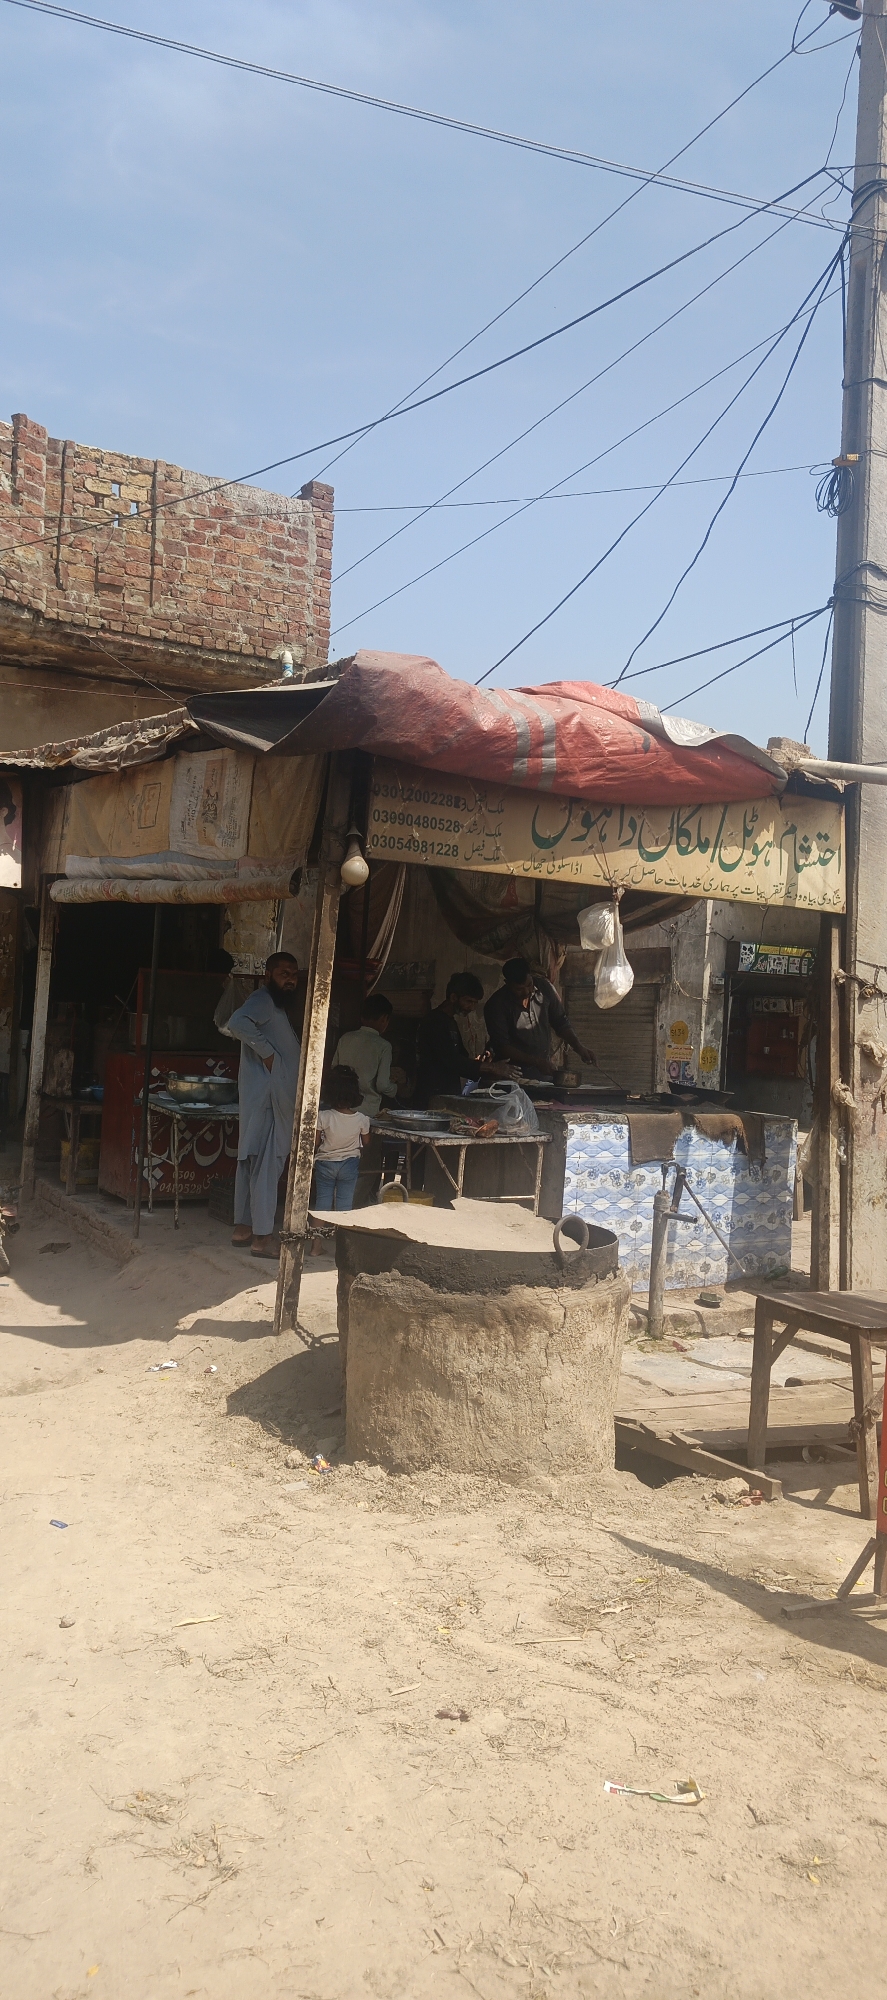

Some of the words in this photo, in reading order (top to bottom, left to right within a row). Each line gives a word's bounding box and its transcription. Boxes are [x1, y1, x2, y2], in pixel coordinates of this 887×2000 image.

[487, 799, 504, 814] ملک
[373, 809, 460, 833] 03090480528
[465, 821, 486, 836] ارشد
[531, 797, 613, 850] ہول
[485, 822, 503, 837] ملک
[371, 834, 459, 857] 03054981228
[464, 840, 485, 860] فیصل
[483, 846, 500, 861] ملک
[780, 823, 842, 876] احتشام
[631, 867, 663, 884] حاصل
[664, 875, 702, 888] خدمات
[702, 878, 730, 892] ہماری
[730, 885, 740, 898] پر
[740, 882, 785, 902] تقریبات
[802, 891, 817, 906] بیاہ
[817, 889, 842, 906] شادی
